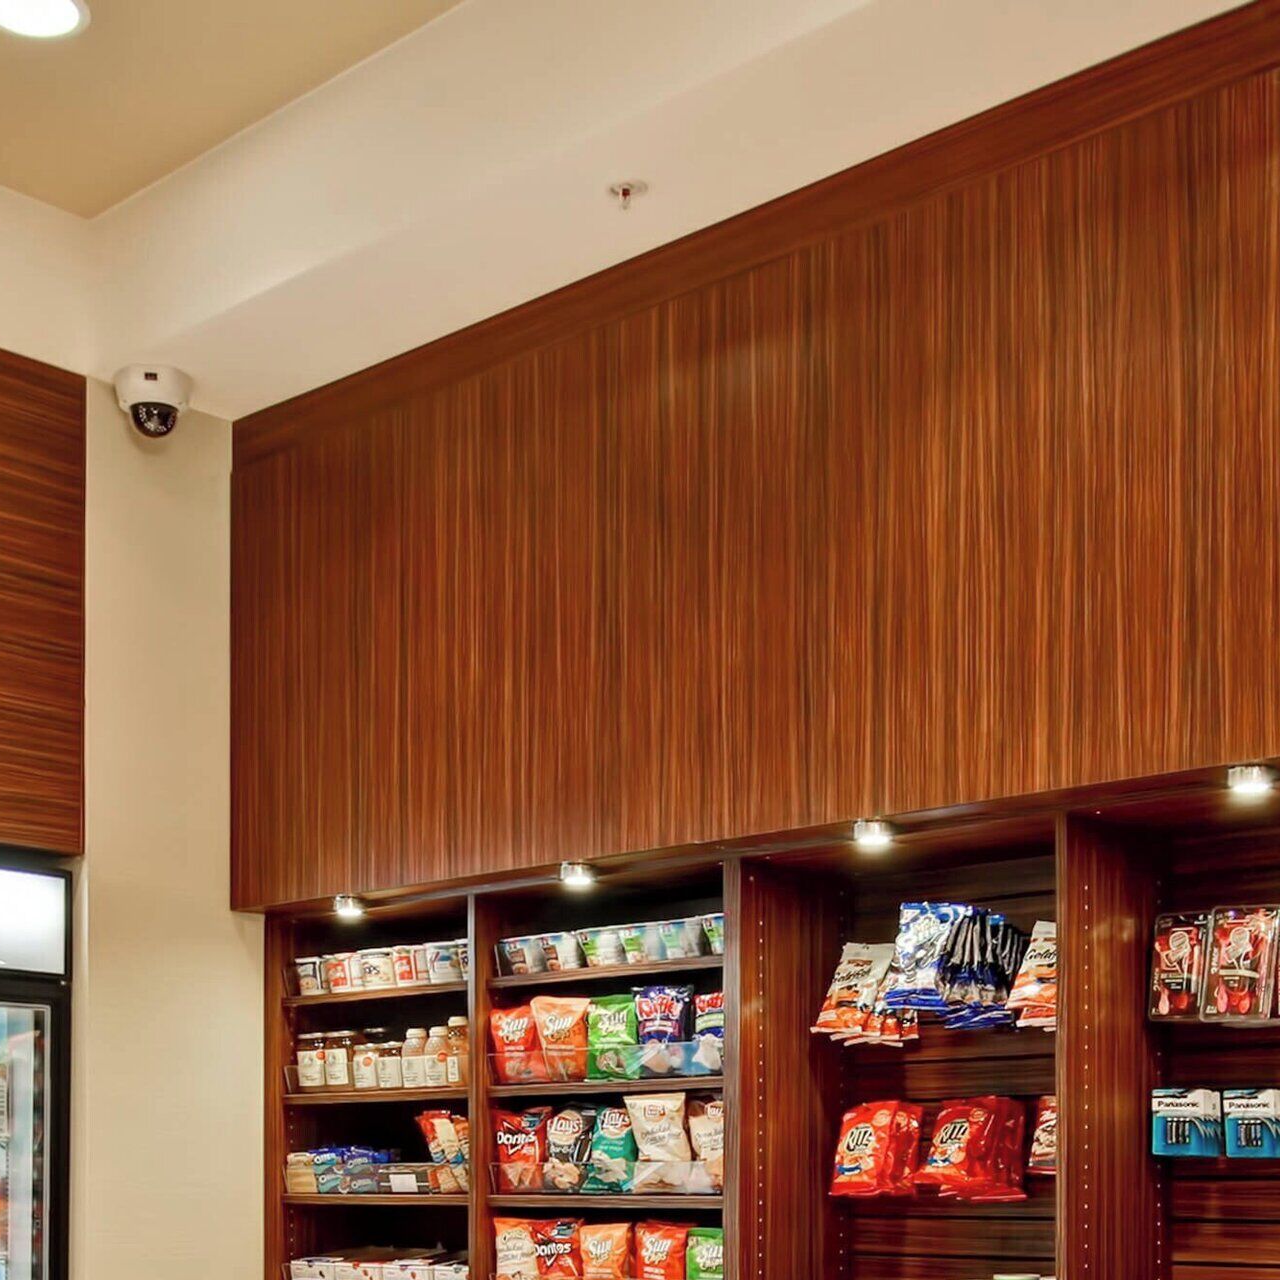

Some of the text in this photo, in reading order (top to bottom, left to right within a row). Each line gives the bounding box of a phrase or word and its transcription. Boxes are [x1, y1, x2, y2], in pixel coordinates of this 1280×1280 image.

[543, 1015, 573, 1038] Sun
[1157, 1100, 1200, 1110] Panasonic
[1228, 1100, 1270, 1110] Panasonic
[844, 1125, 873, 1152] RITZ
[940, 1120, 970, 1145] RITZ
[641, 1237, 673, 1257] Sun
